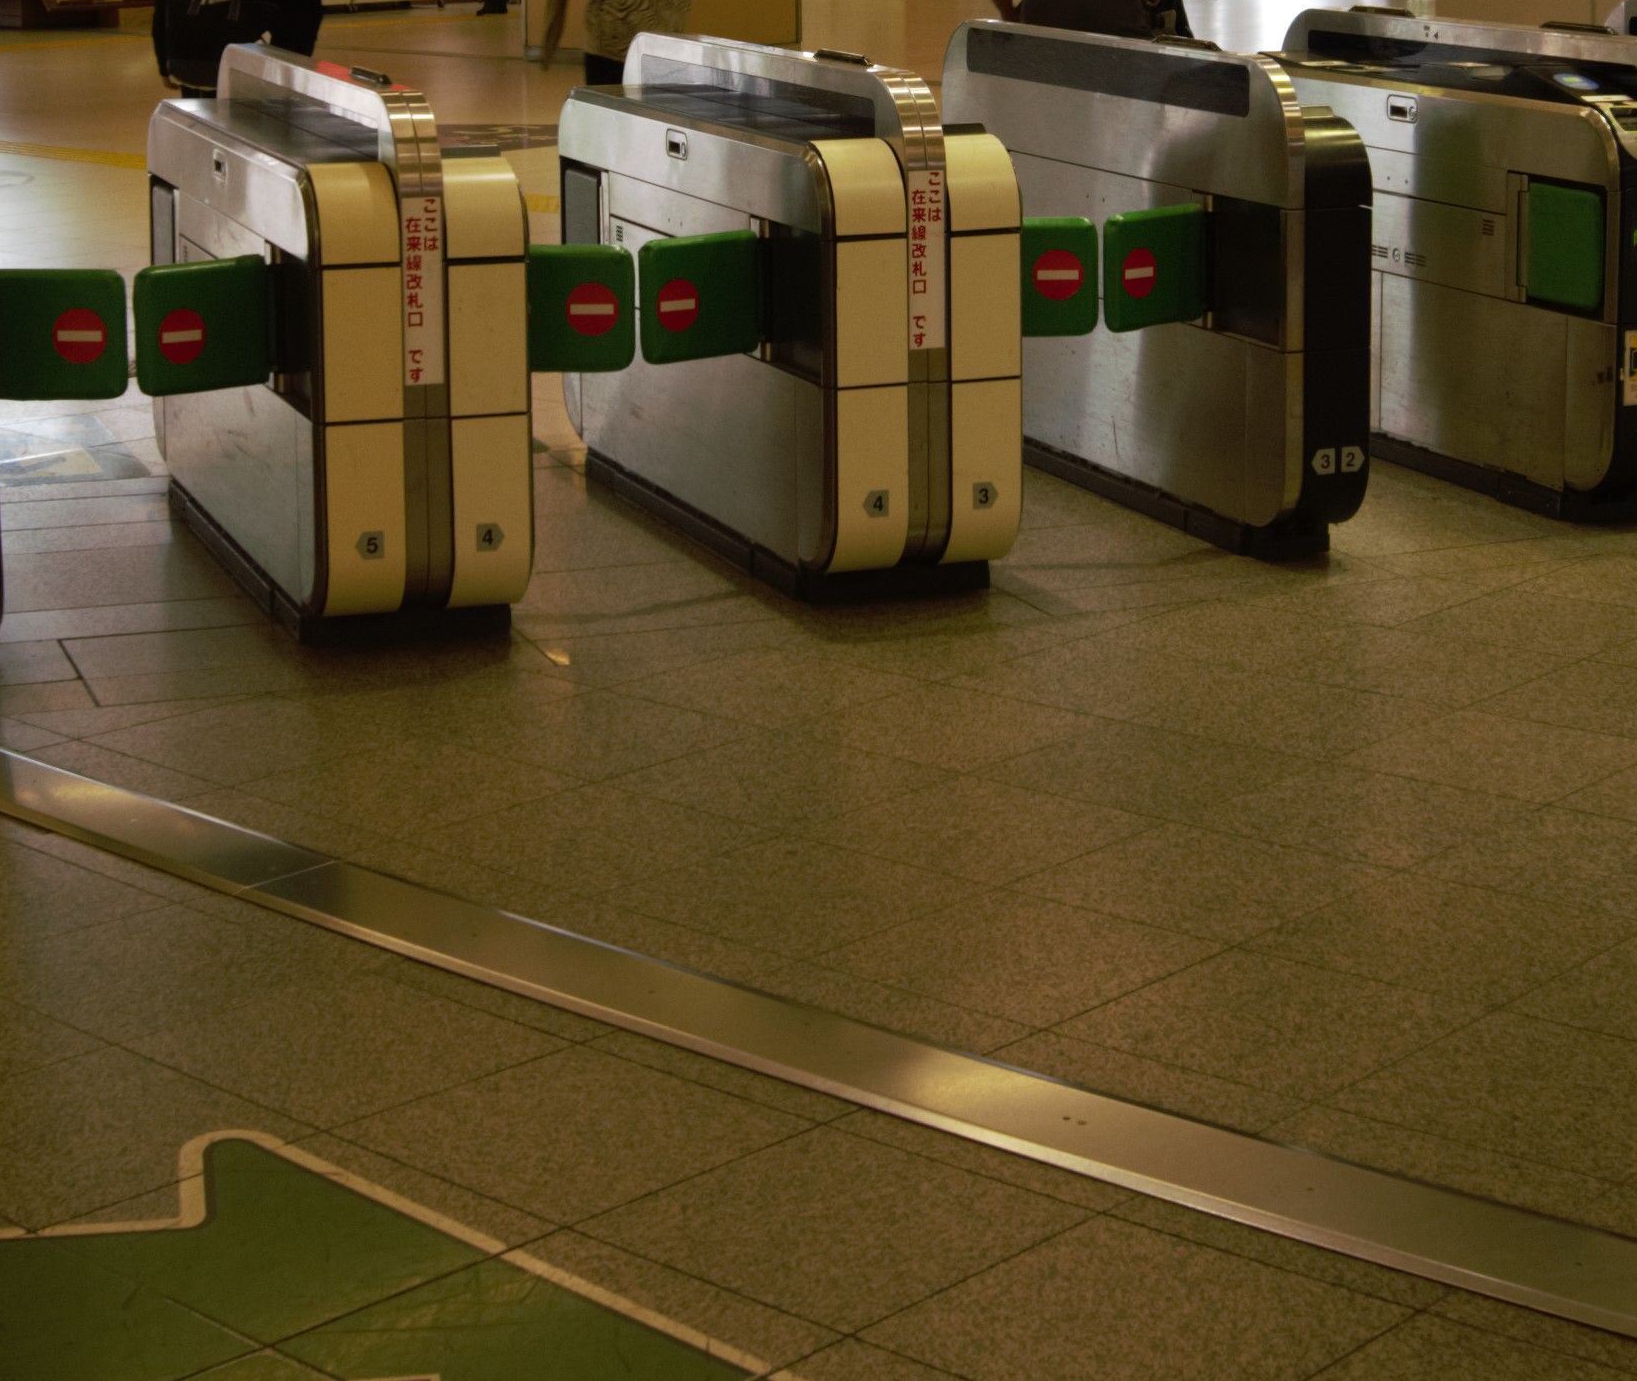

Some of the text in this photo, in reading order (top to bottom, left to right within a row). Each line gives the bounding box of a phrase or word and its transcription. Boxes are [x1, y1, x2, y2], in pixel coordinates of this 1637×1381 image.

[928, 171, 941, 222] ここは
[423, 198, 439, 252] ここは
[911, 188, 926, 347] 在来線改札口 です
[405, 217, 423, 382] 在来線改札口 です
[1321, 455, 1331, 469] 3
[1346, 452, 1355, 467] 2
[873, 495, 883, 512] 4
[979, 488, 988, 504] 3
[366, 537, 378, 553] 5
[482, 528, 494, 545] 4
